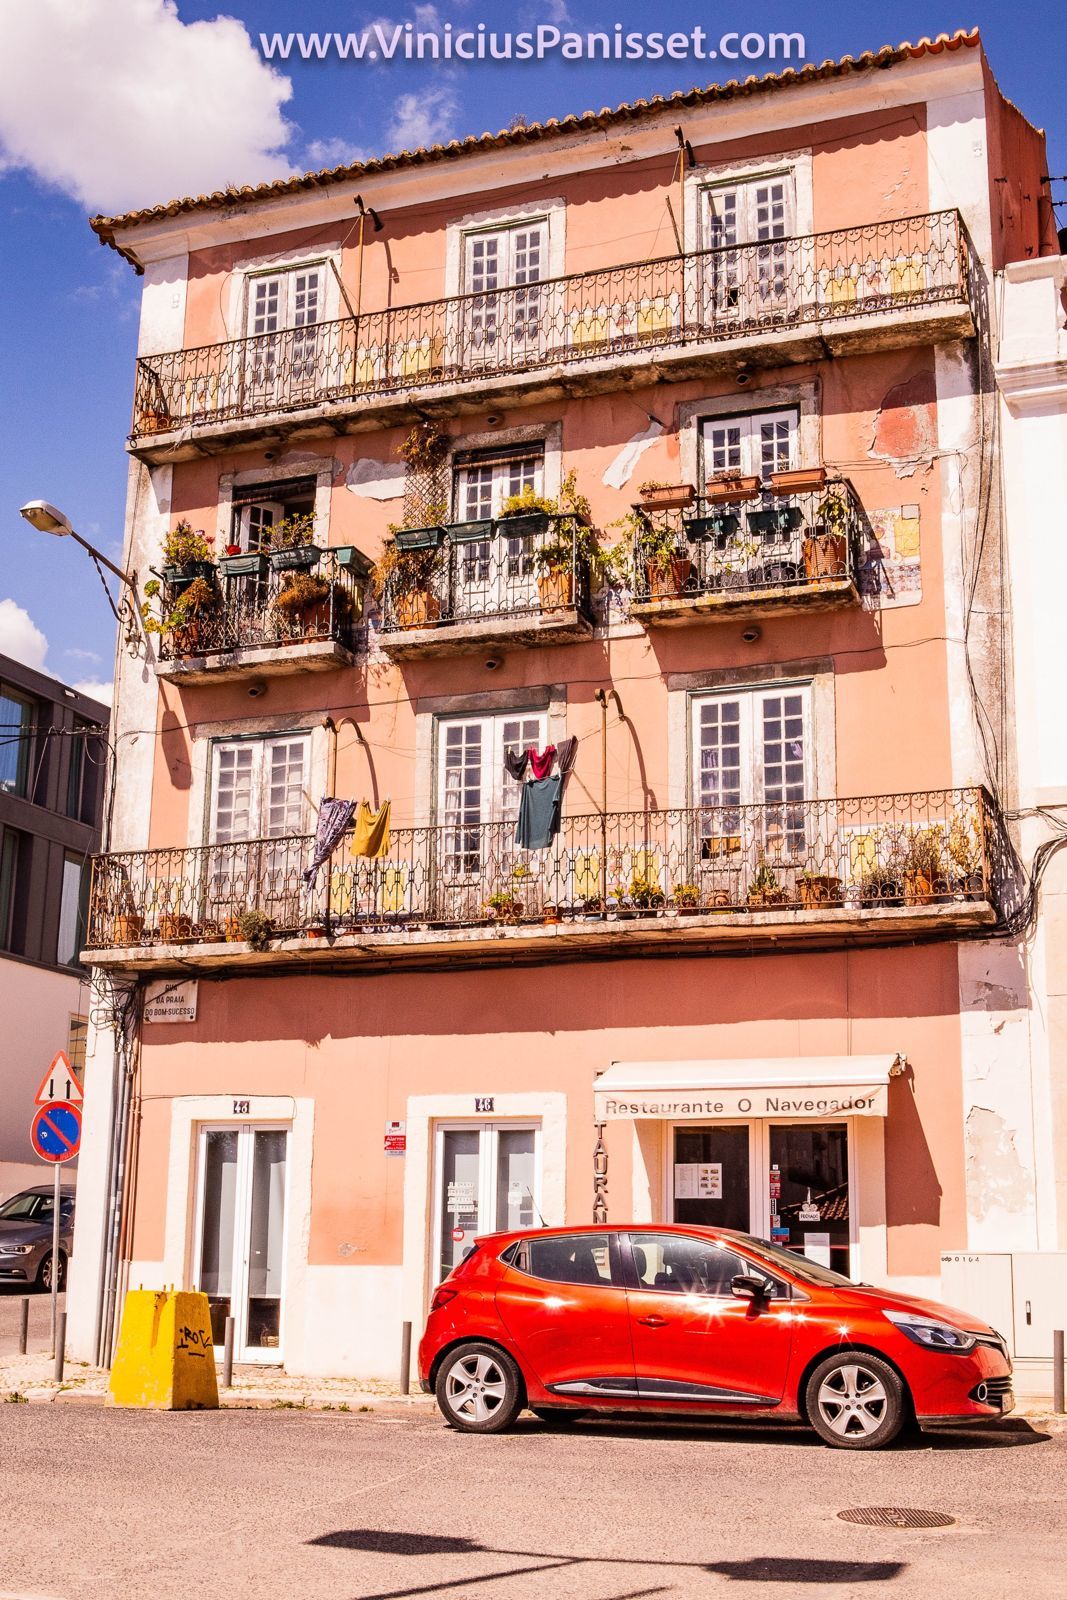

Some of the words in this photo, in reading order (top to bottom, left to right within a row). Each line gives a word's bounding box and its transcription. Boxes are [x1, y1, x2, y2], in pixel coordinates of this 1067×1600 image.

[156, 996, 165, 1004] DA
[166, 995, 185, 1004] PRAIA
[145, 1008, 154, 1016] DO
[154, 1007, 195, 1016] BOM-SUCESSO
[605, 1098, 724, 1114] Restaurante
[737, 1098, 752, 1113] O
[766, 1095, 875, 1113] Navegador
